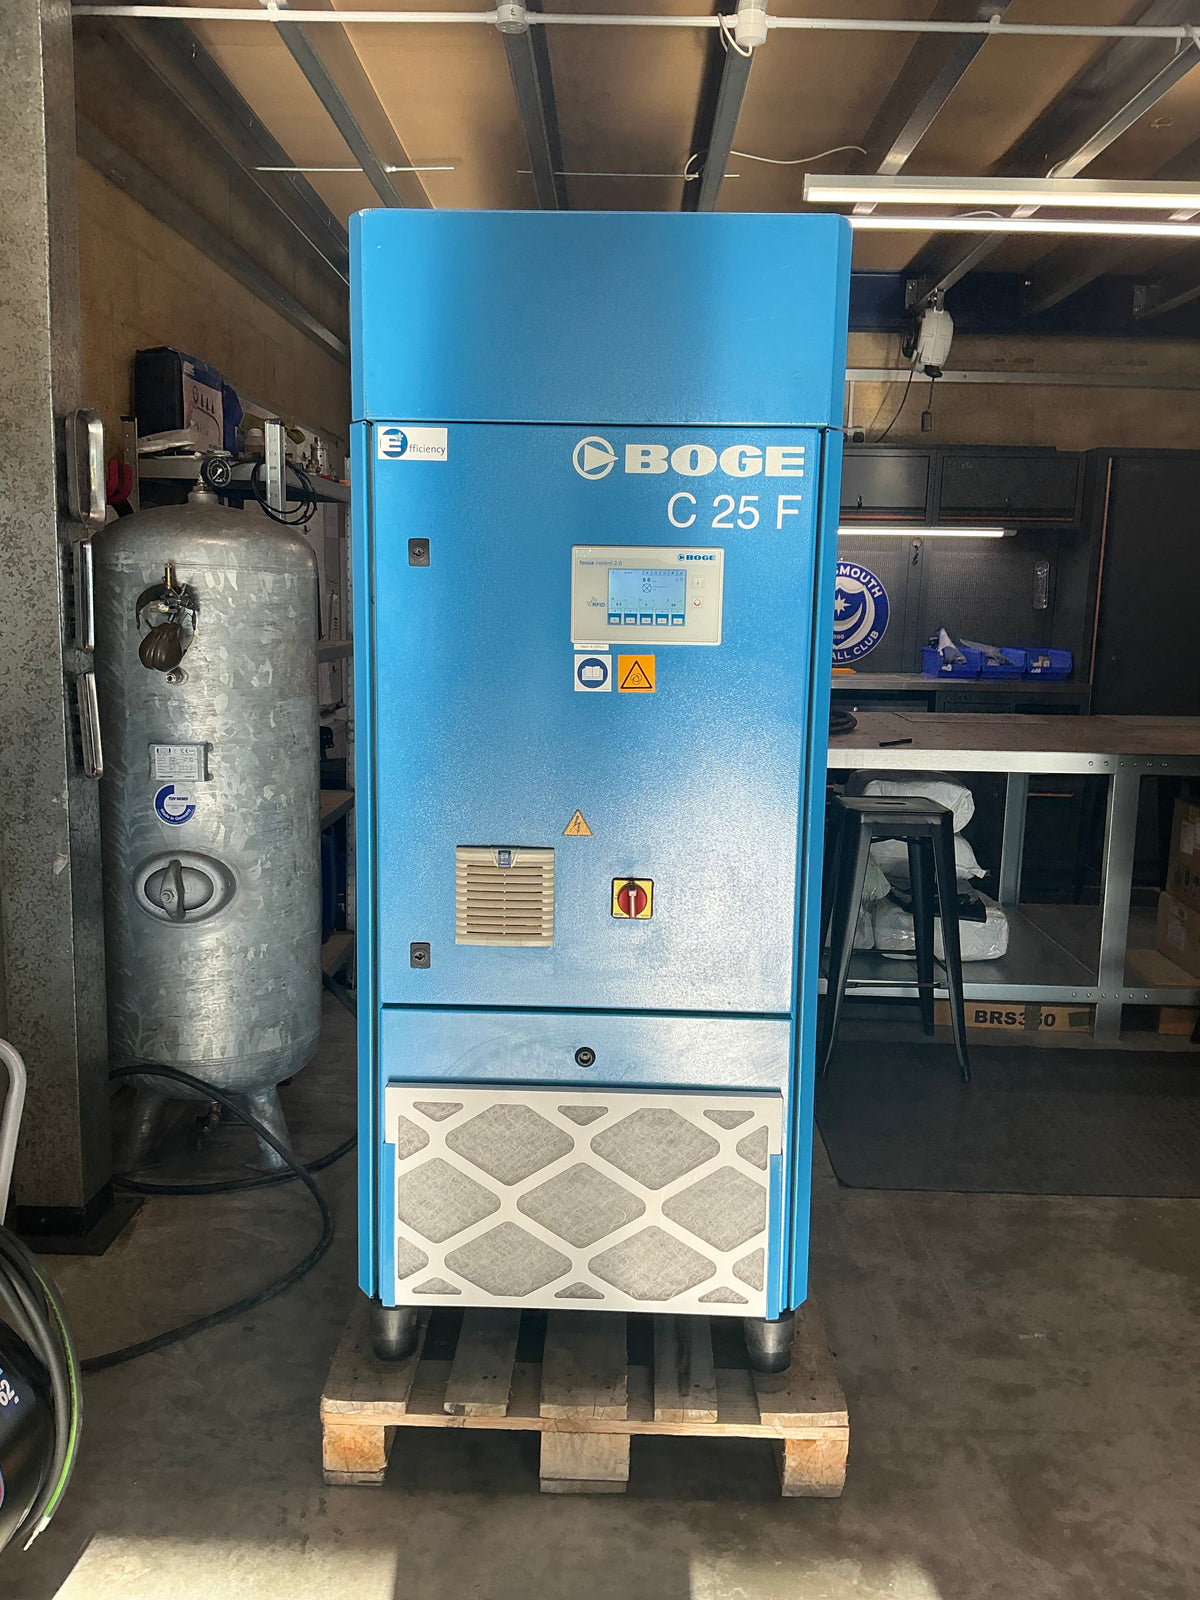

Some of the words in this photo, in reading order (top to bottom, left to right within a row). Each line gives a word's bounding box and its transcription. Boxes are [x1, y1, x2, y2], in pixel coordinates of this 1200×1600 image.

[624, 444, 805, 478] BOGE
[667, 492, 697, 528] C
[711, 494, 760, 530] 25
[776, 494, 802, 530] F
[836, 565, 882, 598] MOUTH
[853, 630, 879, 655] CLUB
[975, 1010, 1056, 1027] BRS30
